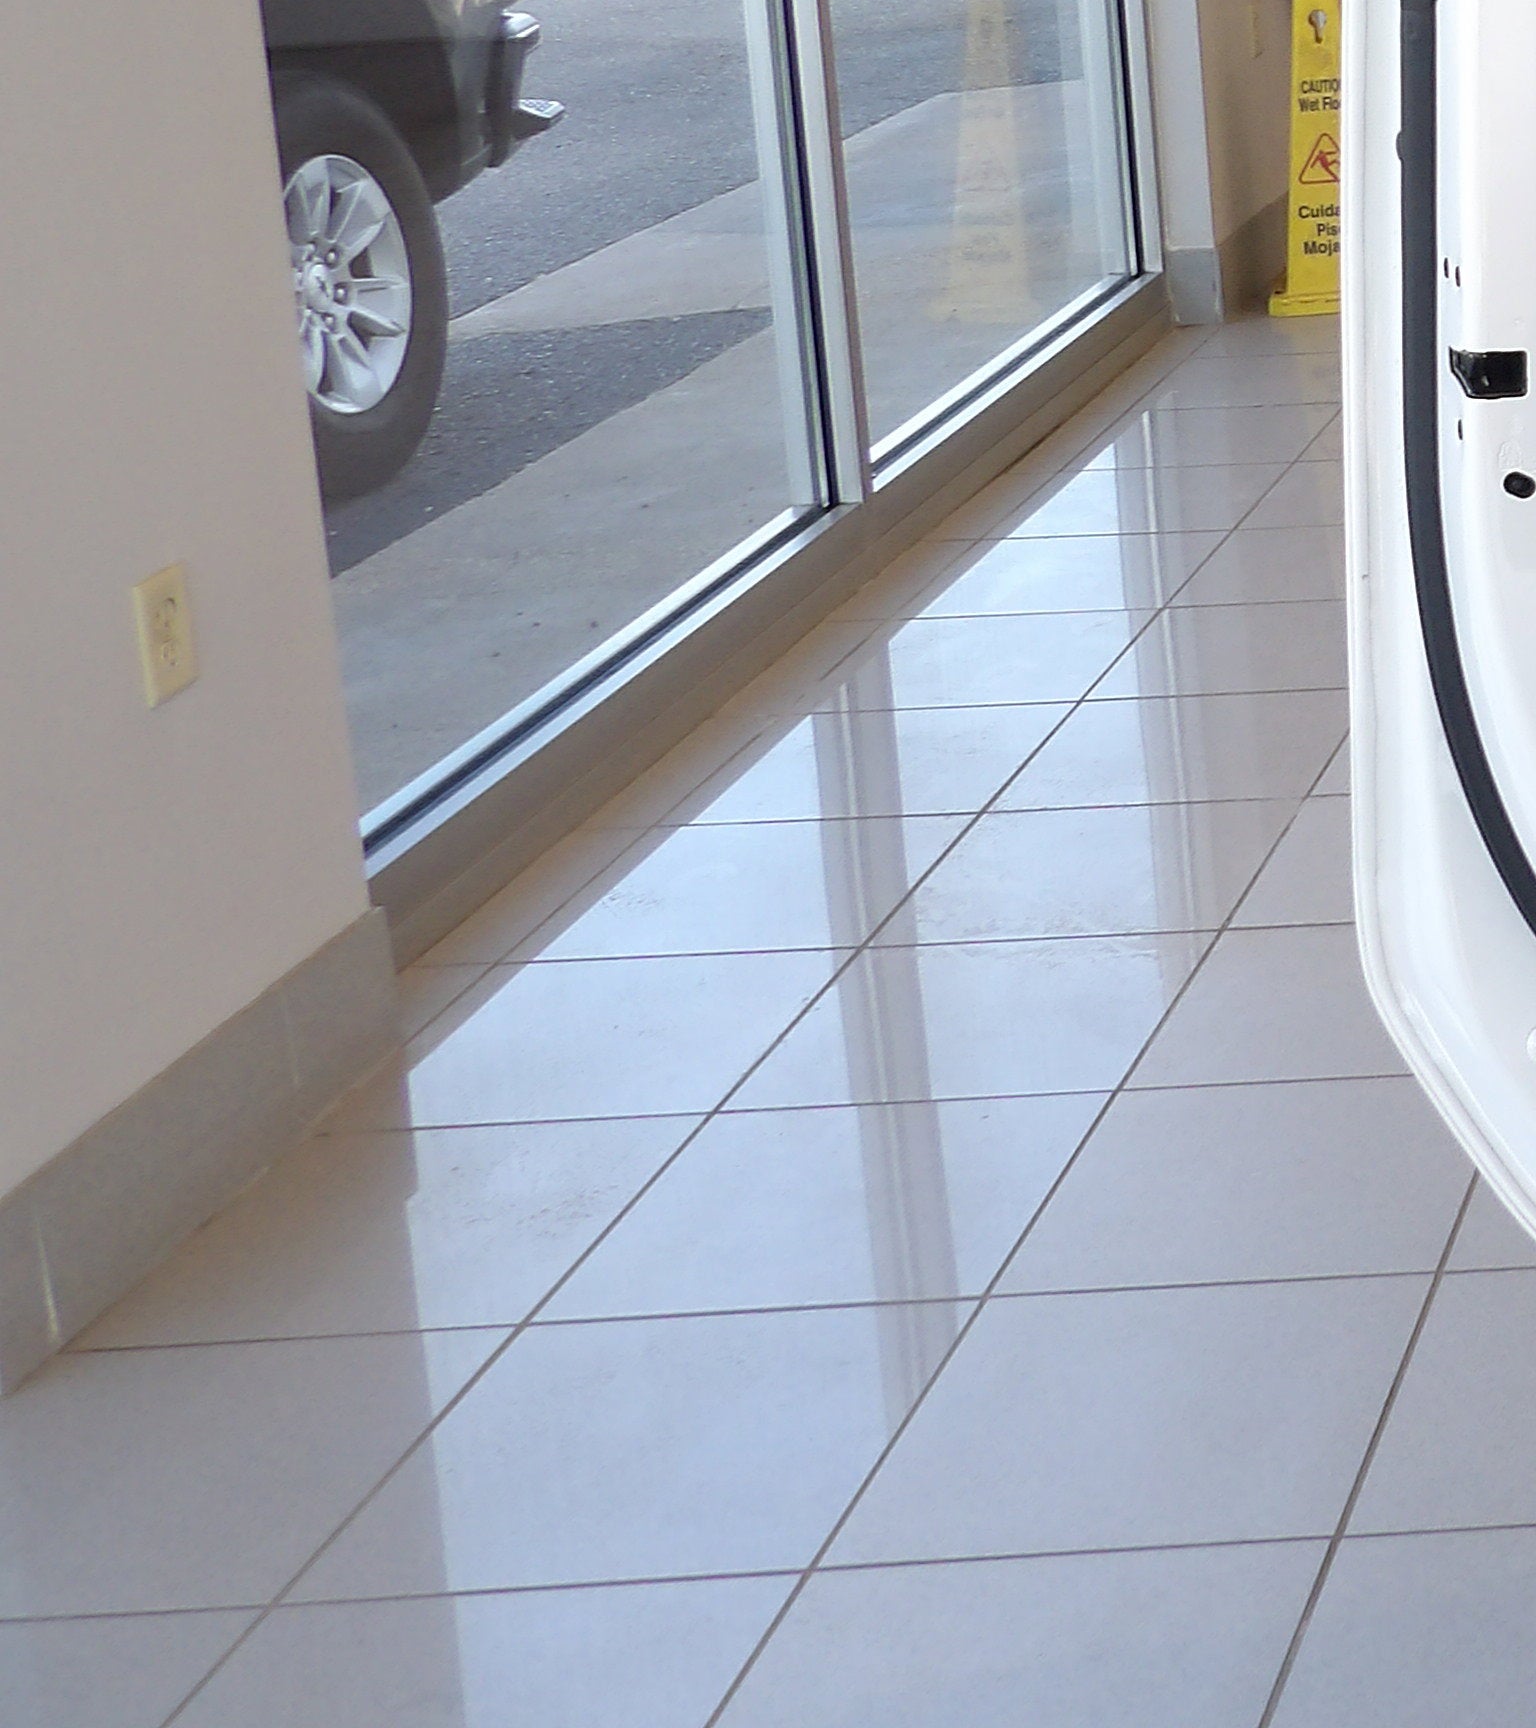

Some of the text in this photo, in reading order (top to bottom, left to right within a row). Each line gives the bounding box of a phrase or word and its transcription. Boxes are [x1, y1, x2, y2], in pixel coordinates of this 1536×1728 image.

[1298, 96, 1341, 112] Wet Flo
[1317, 222, 1341, 237] Pis
